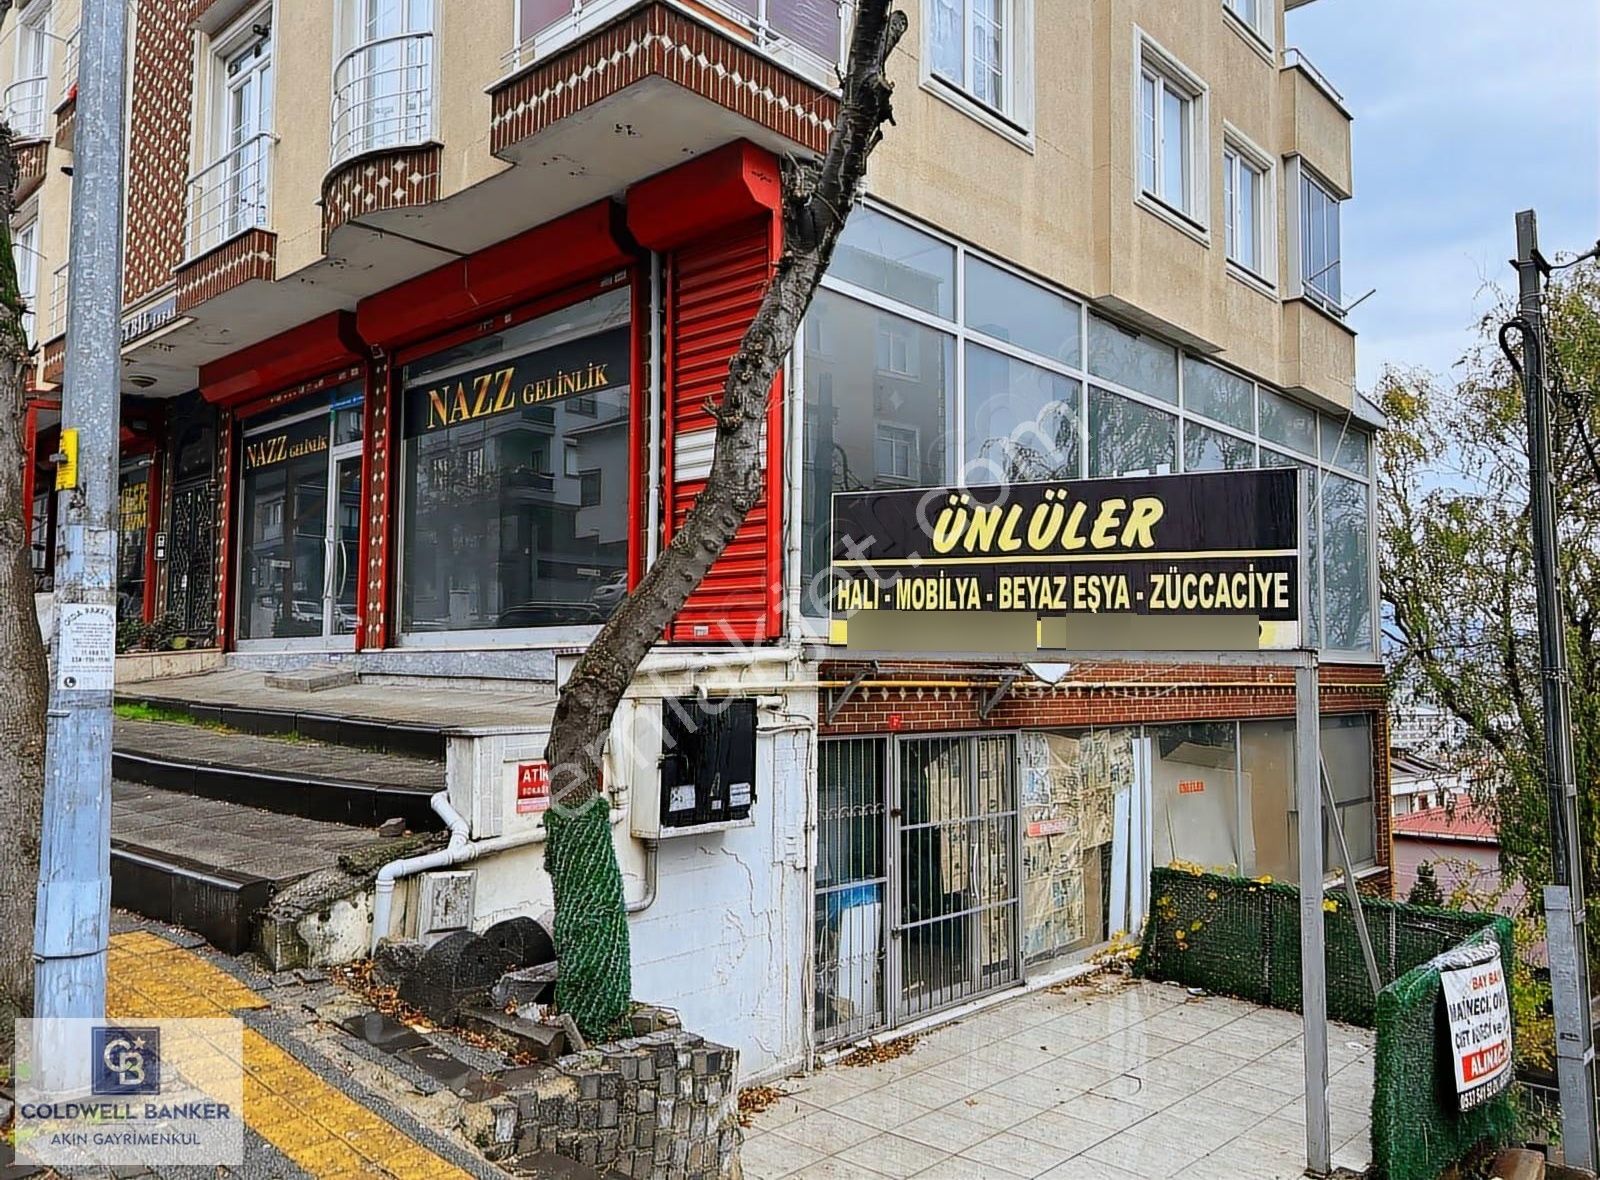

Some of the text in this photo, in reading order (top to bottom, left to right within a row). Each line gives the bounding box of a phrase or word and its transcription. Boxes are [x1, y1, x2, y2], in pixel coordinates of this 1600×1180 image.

[427, 362, 608, 429] NAZZ GELİNLİK
[245, 435, 288, 469] NAZZ
[932, 488, 1164, 554] ÜNLÜLER
[837, 577, 880, 611] HALI
[896, 569, 982, 610] MOBİLYA
[999, 576, 1067, 610] BEYAZ
[1073, 574, 1131, 614] EŞYA
[1149, 563, 1289, 609] ZÜCCACİYE
